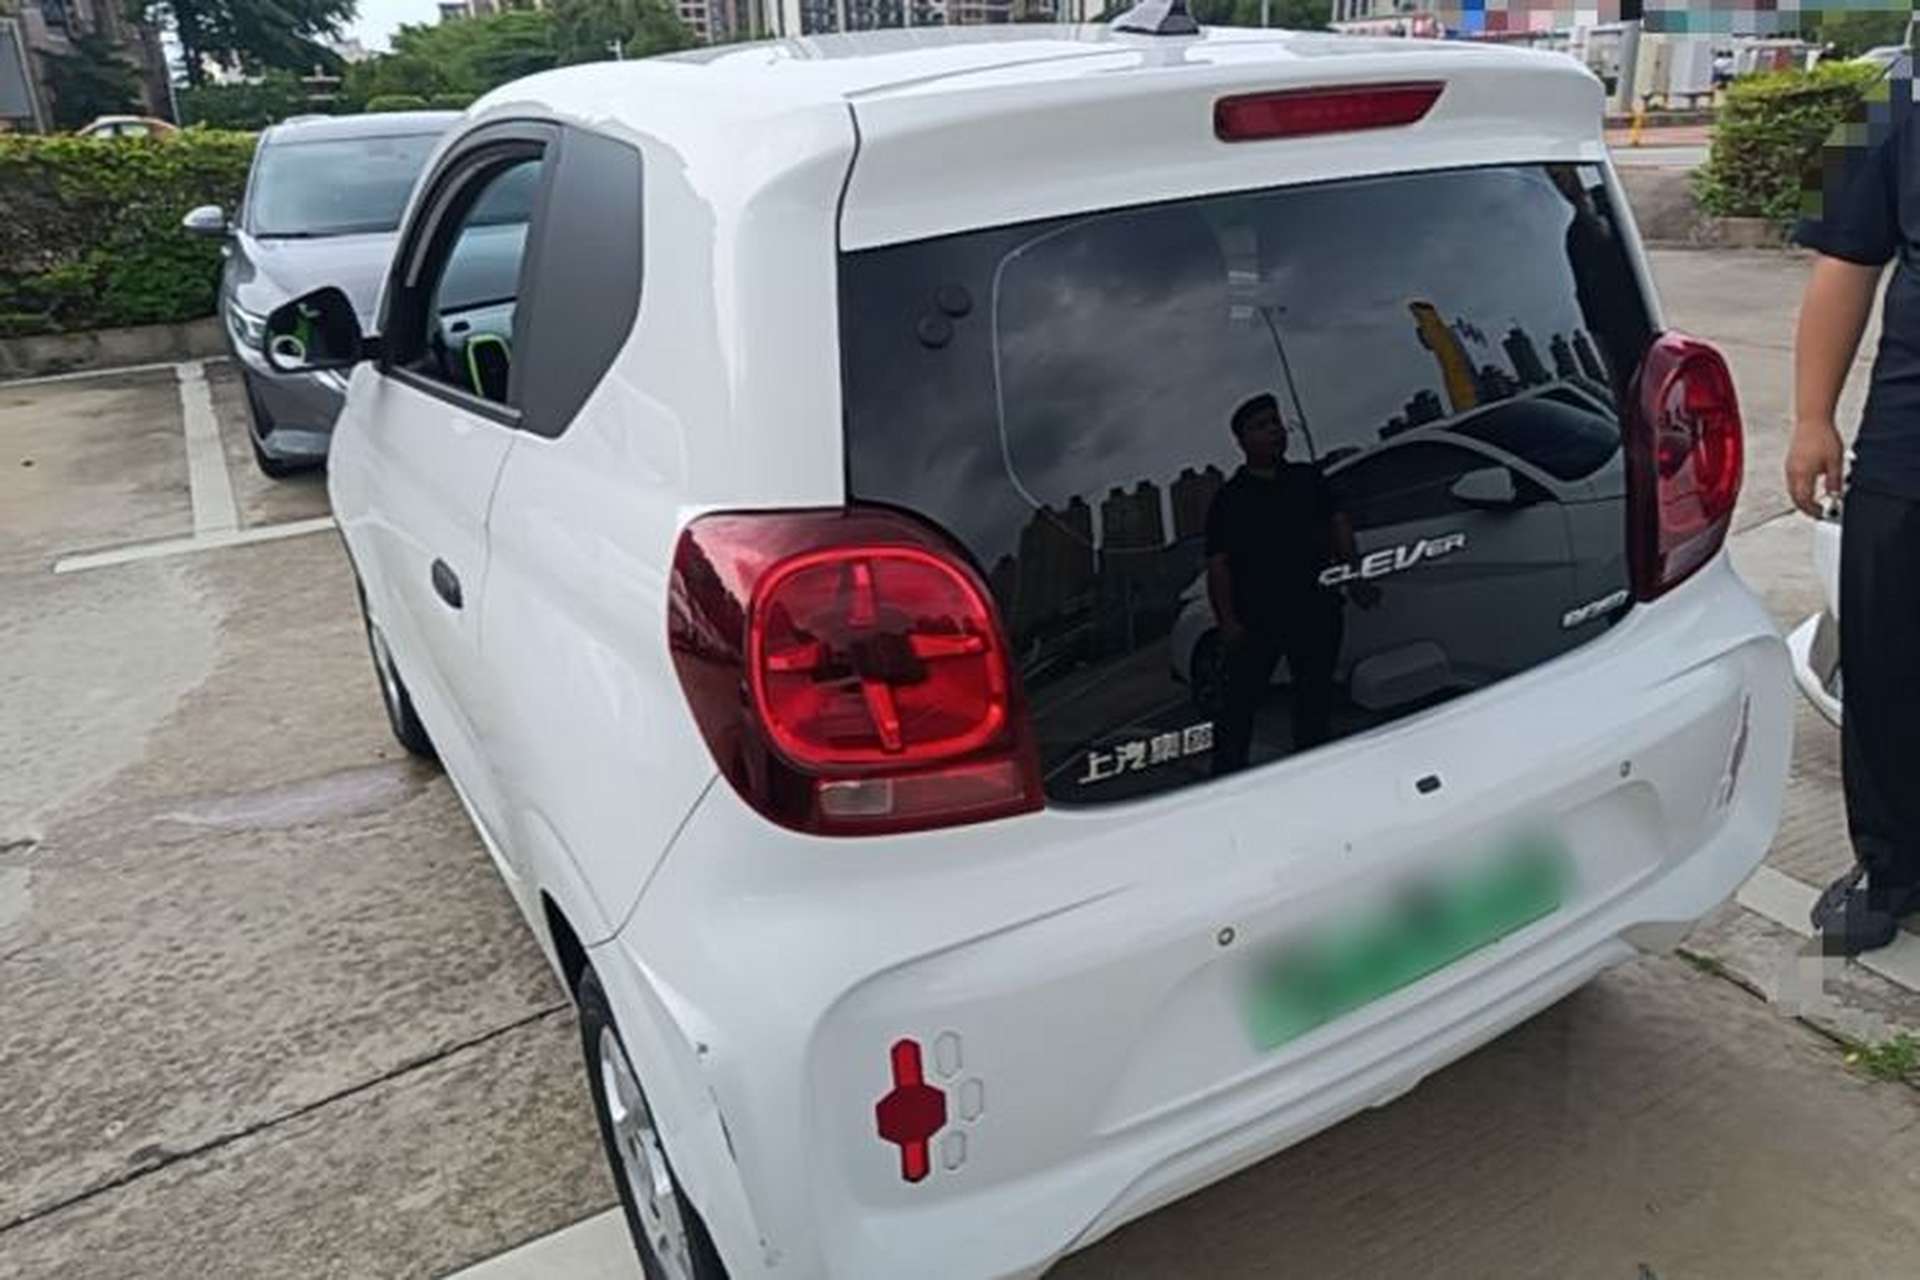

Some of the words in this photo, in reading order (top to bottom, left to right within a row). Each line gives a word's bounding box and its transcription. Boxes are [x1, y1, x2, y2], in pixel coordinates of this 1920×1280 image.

[1318, 533, 1466, 586] CLEVER
[1077, 720, 1214, 785] 上汽集团
